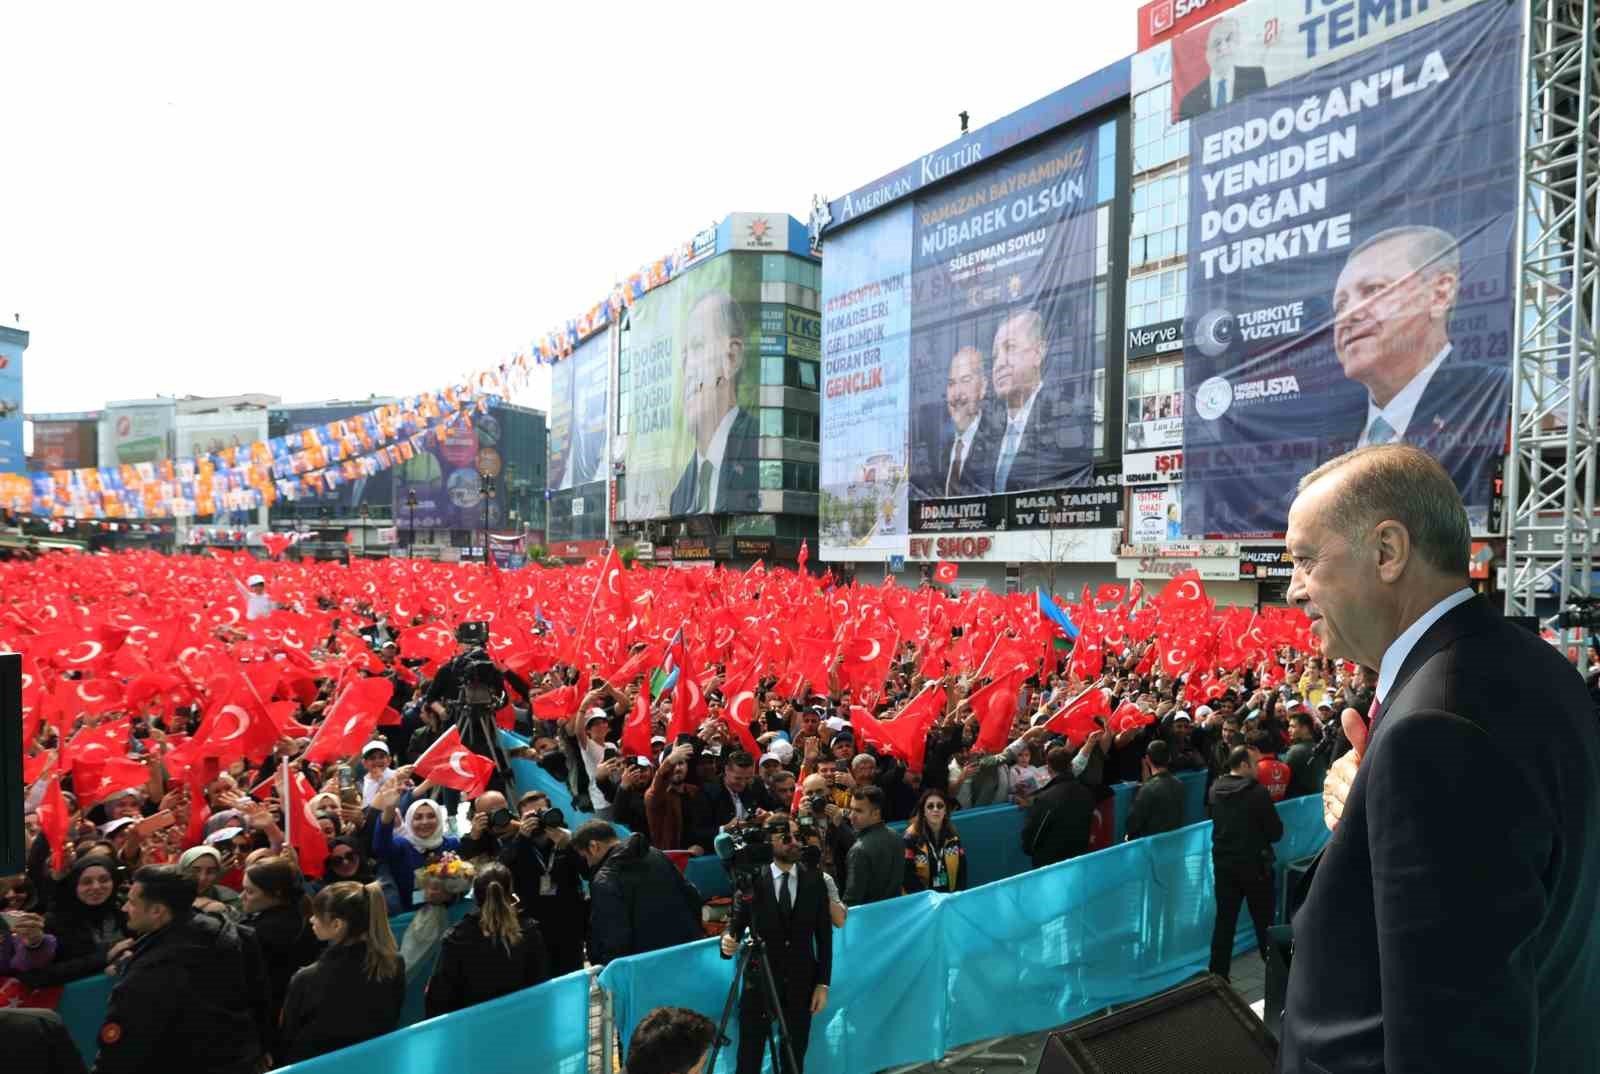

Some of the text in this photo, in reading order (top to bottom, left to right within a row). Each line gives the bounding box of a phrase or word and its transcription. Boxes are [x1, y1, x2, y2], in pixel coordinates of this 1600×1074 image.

[920, 143, 982, 187] KÜLTÜR
[921, 146, 1086, 225] RAMAZAN BAYRAMINIZ
[1200, 126, 1357, 202] YENİDEN
[921, 176, 1084, 257] MÜBAREK OLSUN
[1200, 178, 1327, 243] DOĞAN
[950, 242, 1006, 273] SÜLEYMAN
[1007, 227, 1046, 253] SOYLU
[1200, 214, 1351, 280] TÜRKİYE
[1129, 326, 1177, 349] Merve
[1263, 376, 1300, 396] USTA
[1015, 491, 1118, 509] MASA TAKIMI
[1016, 507, 1101, 525] TV ÜNİTESİ
[909, 536, 992, 559] EV SHOP
